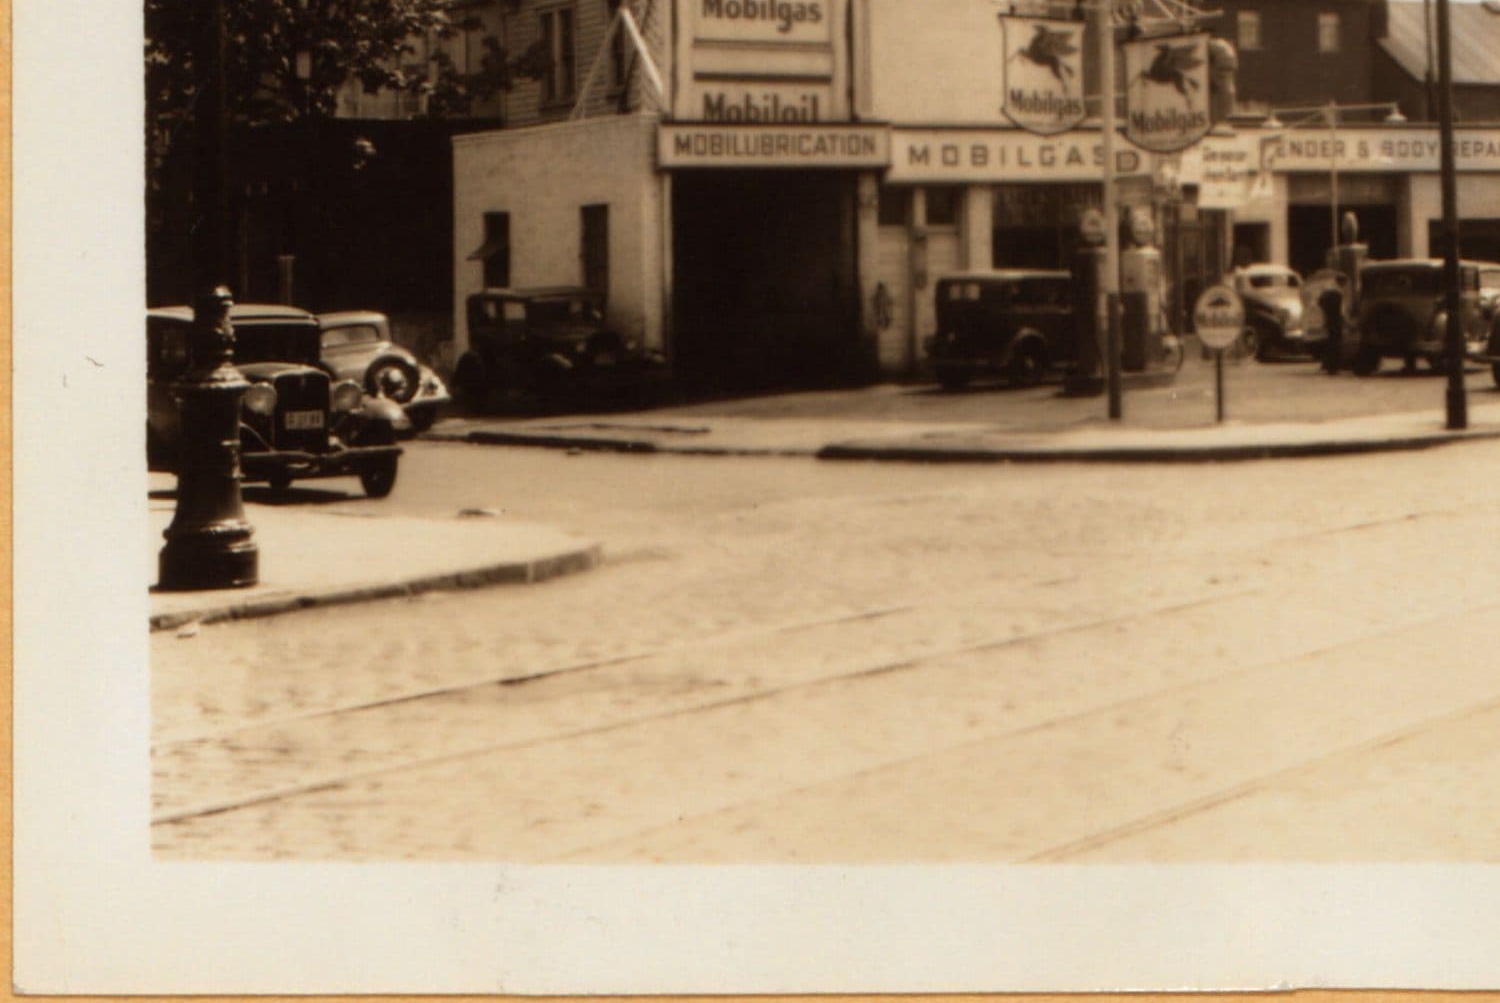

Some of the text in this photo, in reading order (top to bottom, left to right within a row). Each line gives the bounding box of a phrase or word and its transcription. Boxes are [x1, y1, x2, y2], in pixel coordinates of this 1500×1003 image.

[702, 92, 820, 123] Mobiloil
[1009, 88, 1083, 120] Mobilgas
[1131, 108, 1207, 138] Mobilgas
[673, 132, 877, 158] MOBILUBRICATION
[907, 143, 1104, 168] MOBILGAS
[1272, 139, 1346, 158] ENDER
[1380, 139, 1438, 159] BODY
